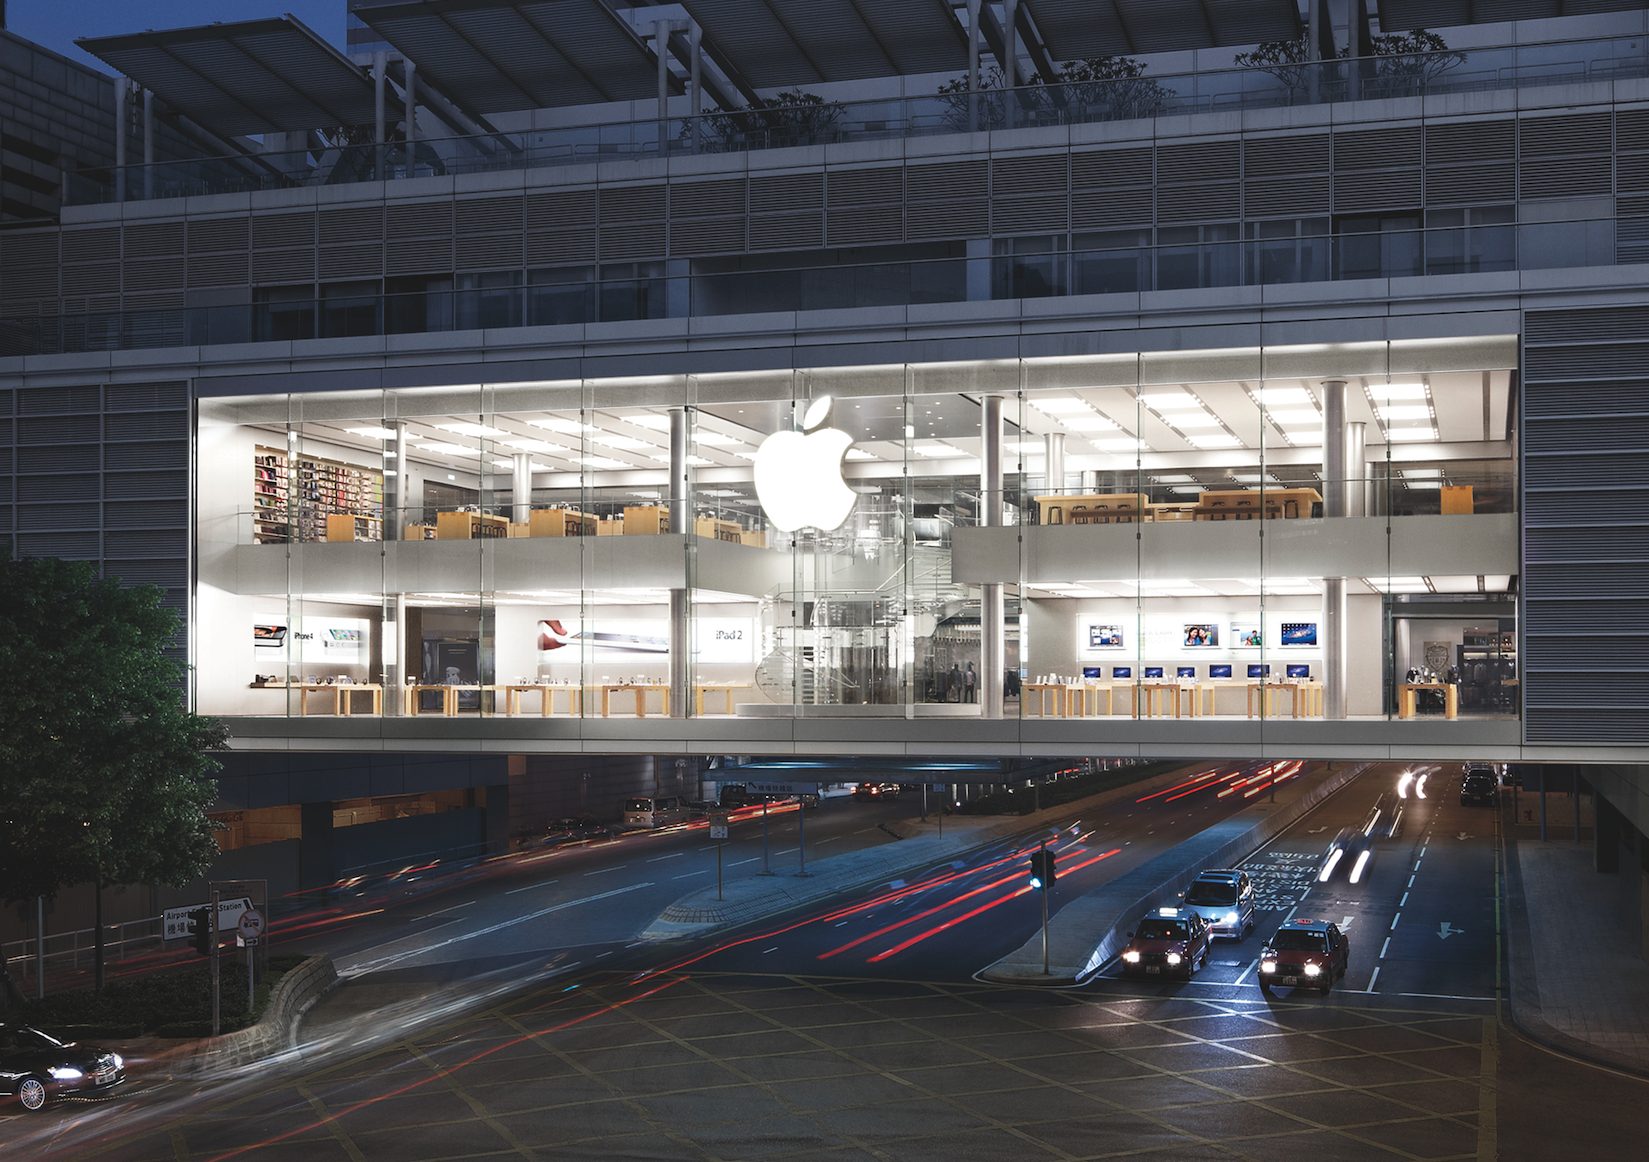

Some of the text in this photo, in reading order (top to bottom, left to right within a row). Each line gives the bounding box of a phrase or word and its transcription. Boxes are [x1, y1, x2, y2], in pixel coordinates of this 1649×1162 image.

[716, 630, 743, 640] iPad 2
[219, 903, 242, 912] Station
